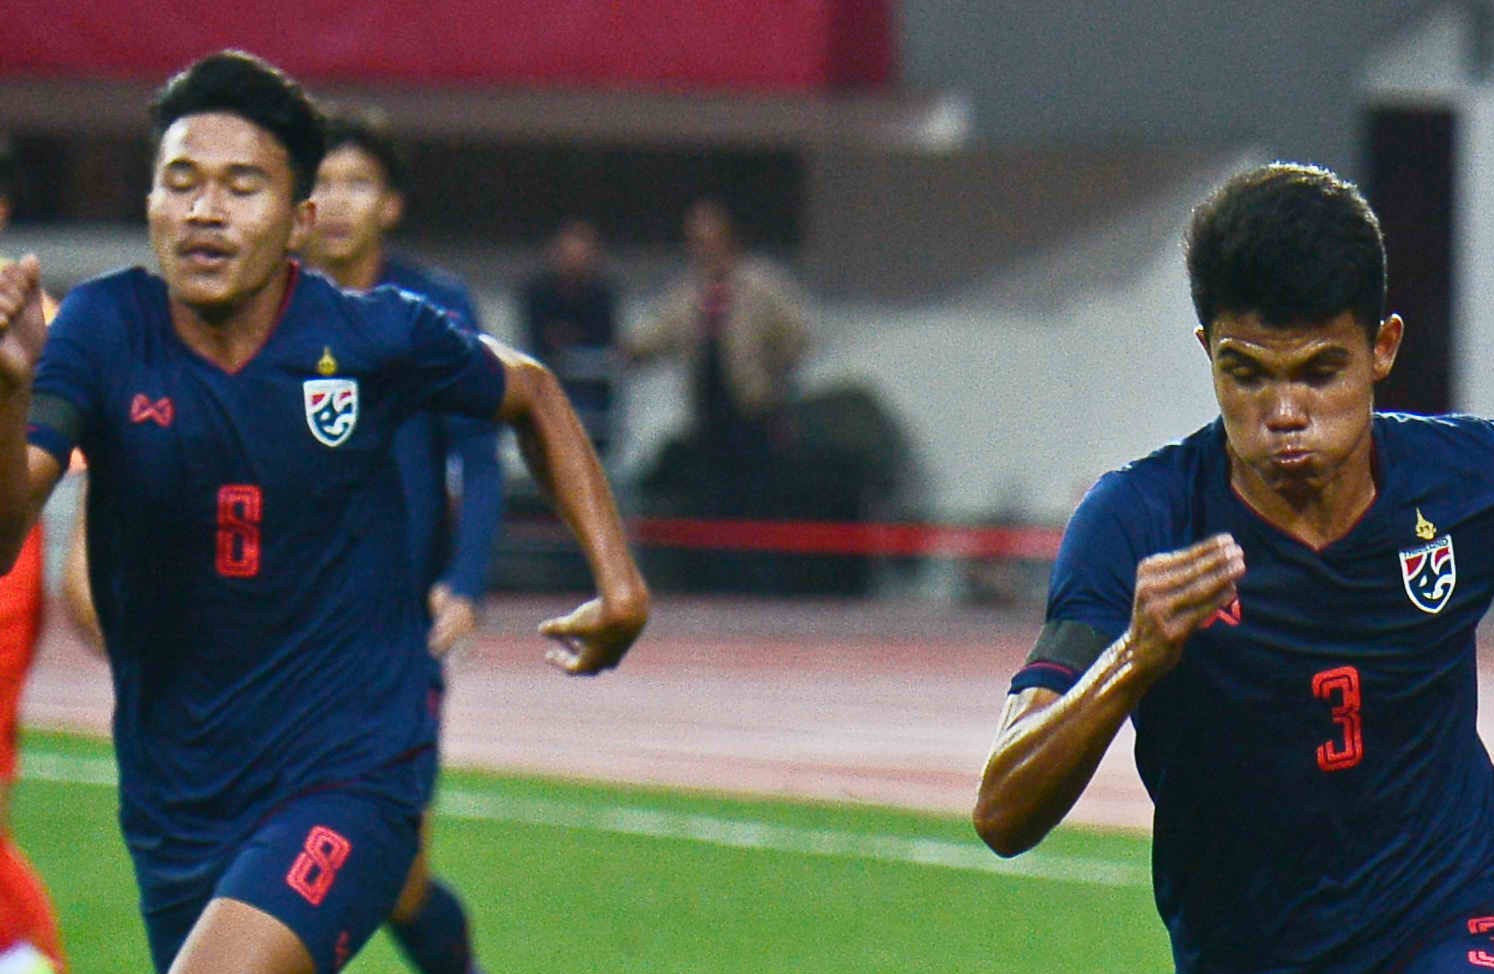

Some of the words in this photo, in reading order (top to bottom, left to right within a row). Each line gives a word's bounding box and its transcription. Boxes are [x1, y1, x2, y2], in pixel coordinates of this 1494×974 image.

[217, 485, 262, 576] 8
[1312, 665, 1364, 772] 3
[286, 825, 351, 906] 8
